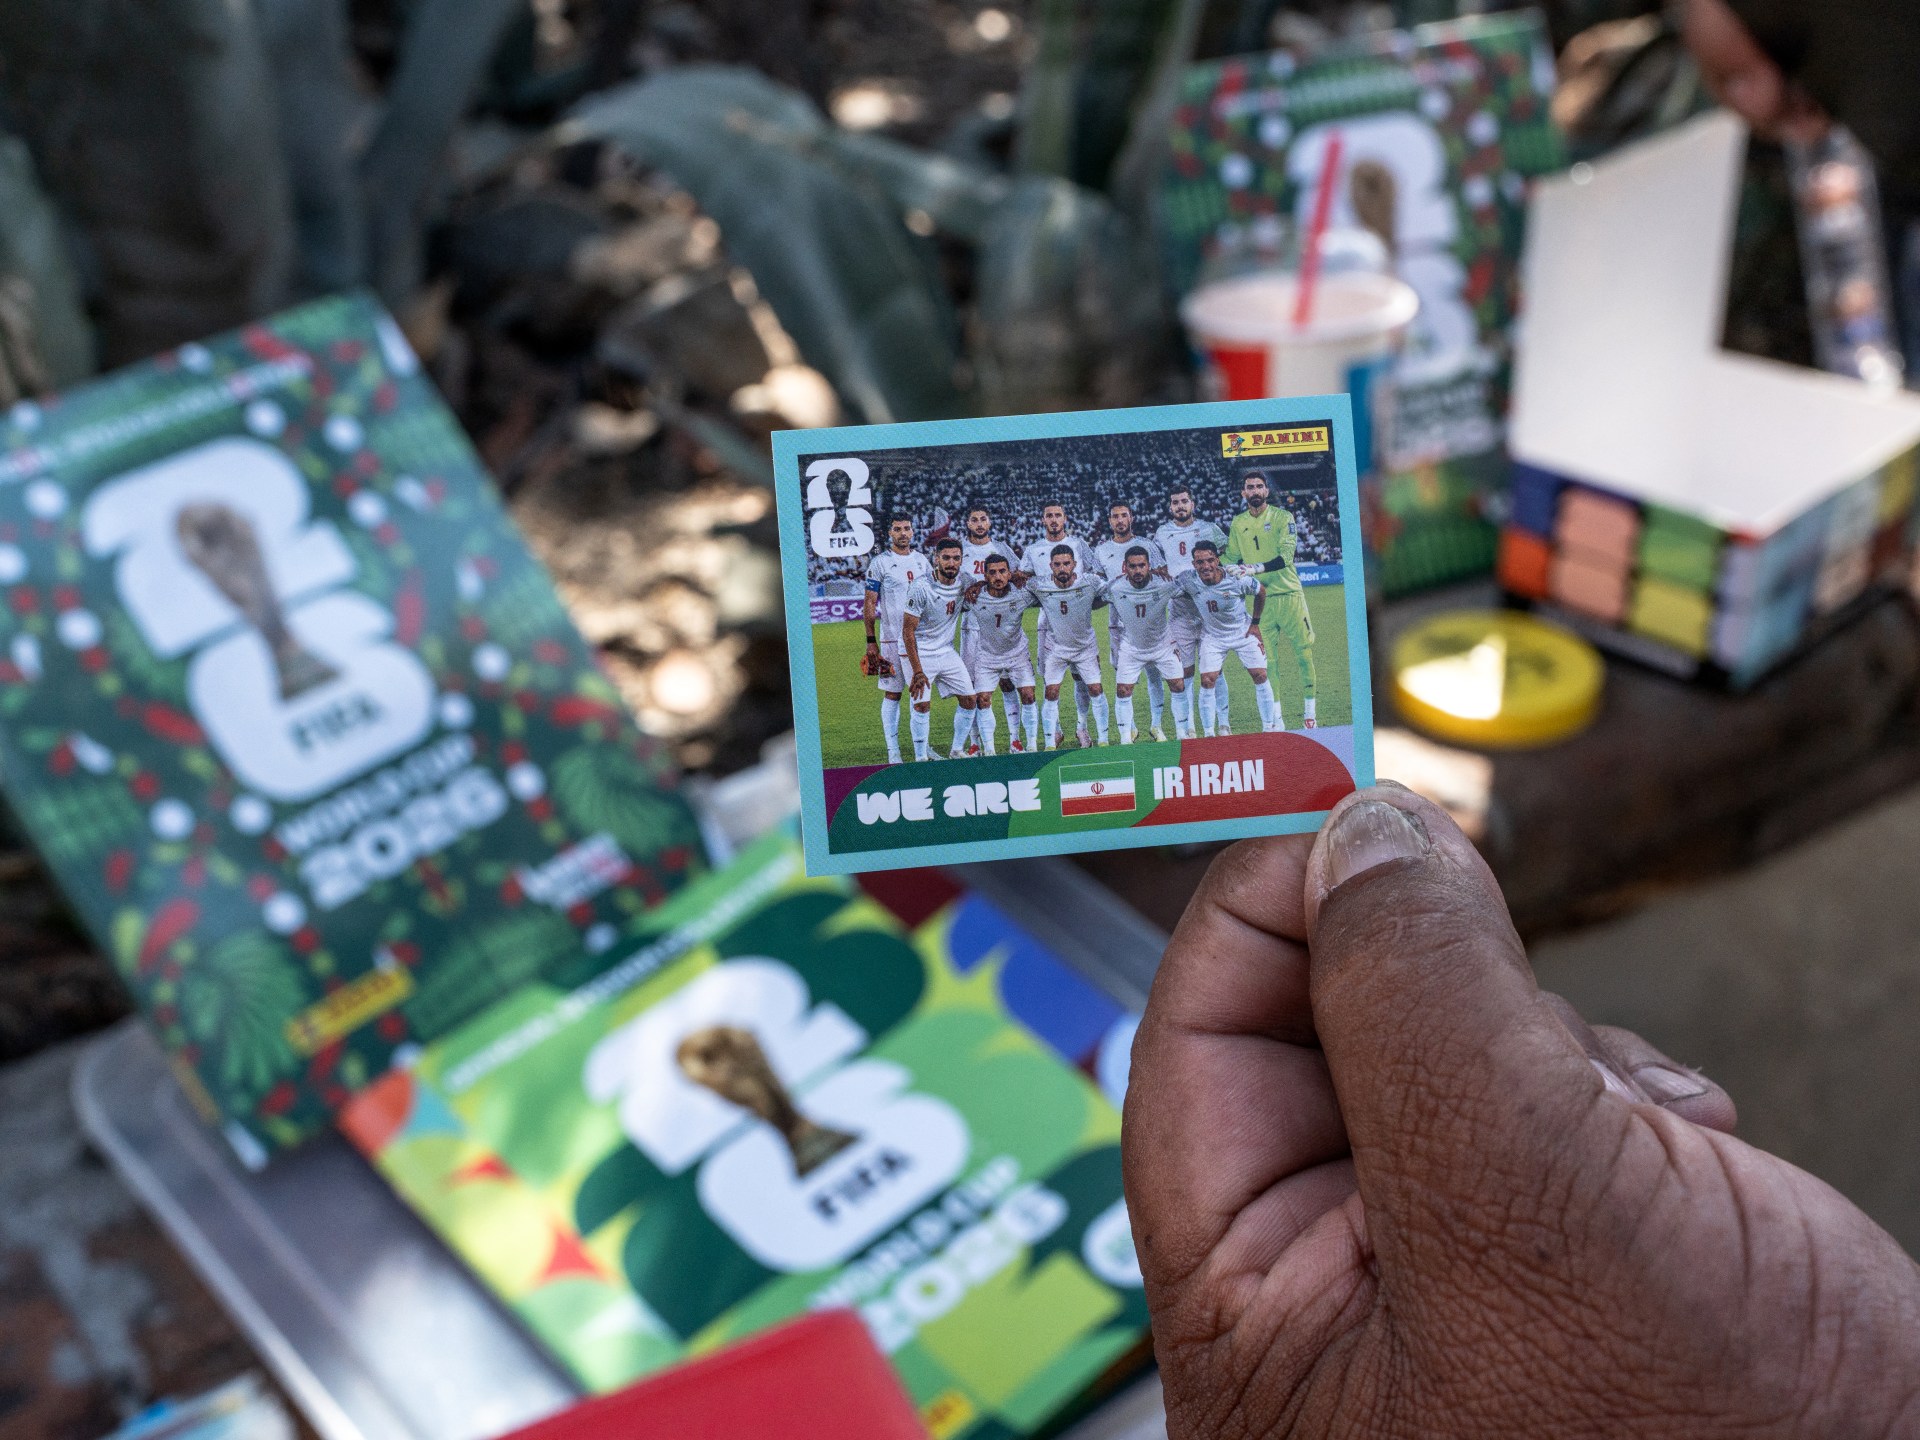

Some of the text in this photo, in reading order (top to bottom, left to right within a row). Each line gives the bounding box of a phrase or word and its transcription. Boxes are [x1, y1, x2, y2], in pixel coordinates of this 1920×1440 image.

[1251, 431, 1324, 446] PANINI
[829, 537, 859, 549] FIFA
[1179, 541, 1188, 557] 6
[1253, 535, 1260, 550] 1
[1060, 601, 1069, 616] 5
[1135, 604, 1147, 618] 17
[995, 614, 1003, 628] 7
[1152, 759, 1265, 800] IR IRAN
[856, 787, 934, 826] WE
[301, 765, 508, 906] 2026
[808, 1151, 909, 1223] FIFA
